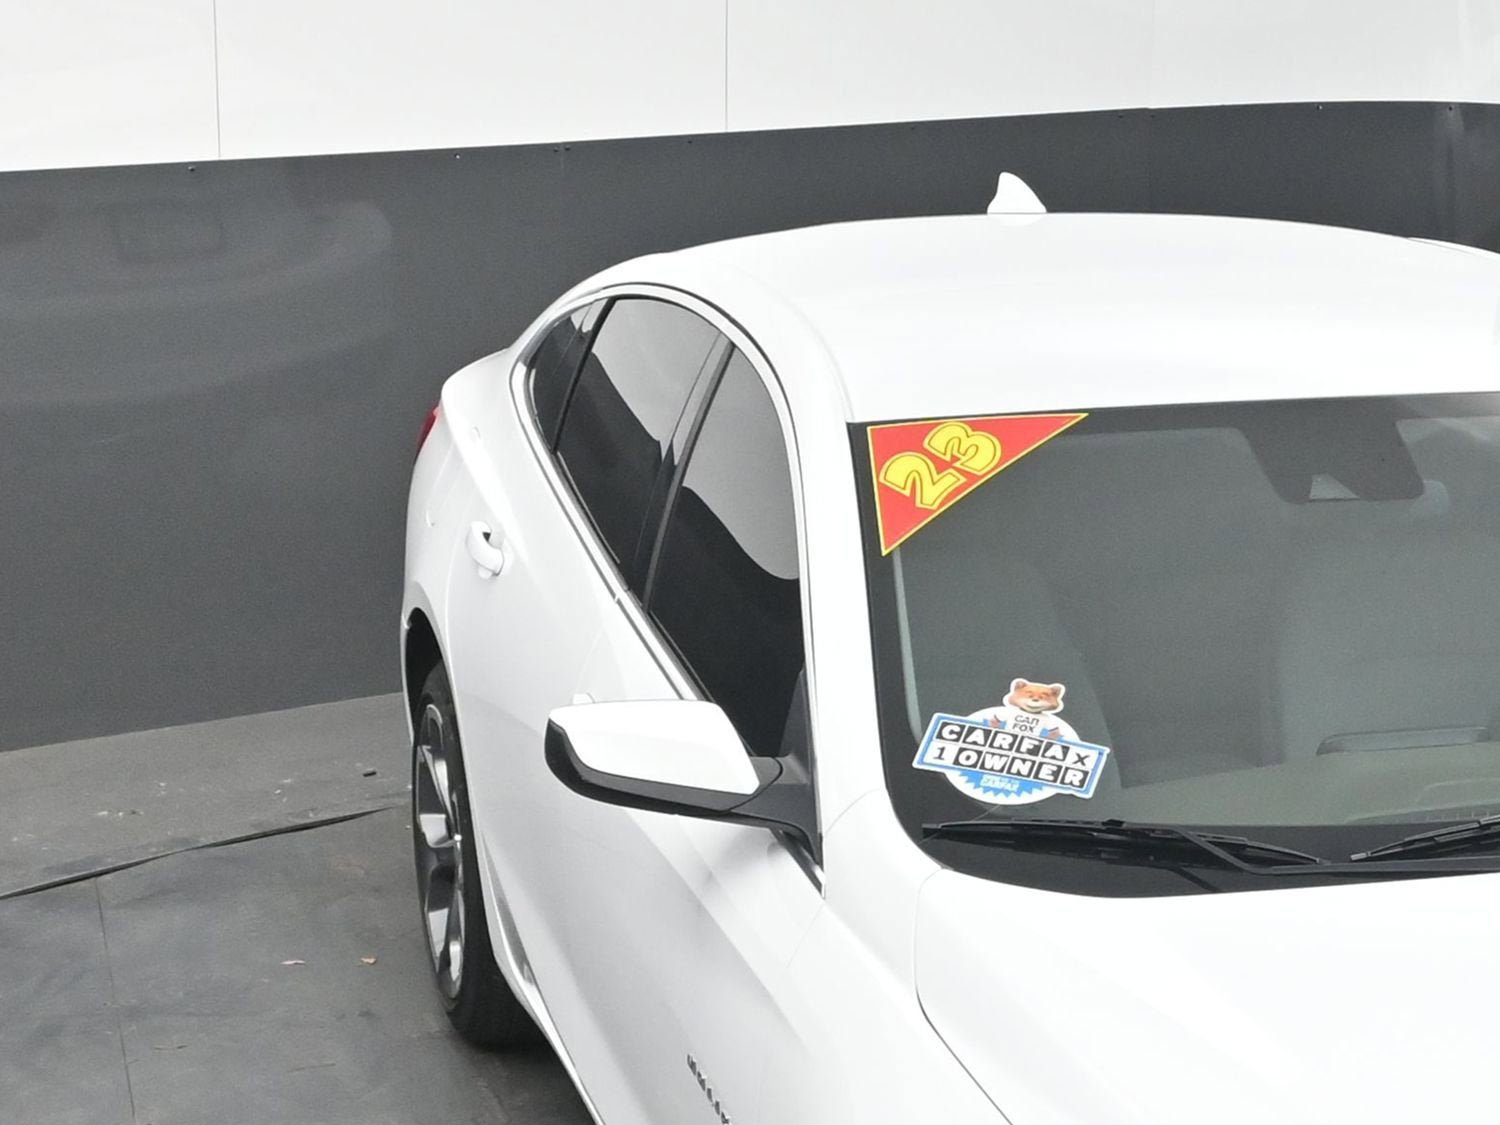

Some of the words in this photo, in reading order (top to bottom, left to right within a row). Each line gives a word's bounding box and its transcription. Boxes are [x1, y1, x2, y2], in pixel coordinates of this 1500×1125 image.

[879, 421, 1002, 510] 23
[939, 723, 1091, 767] CARFAX
[1012, 722, 1036, 733] FOX
[932, 746, 946, 761] 1
[956, 751, 1087, 788] OWNER
